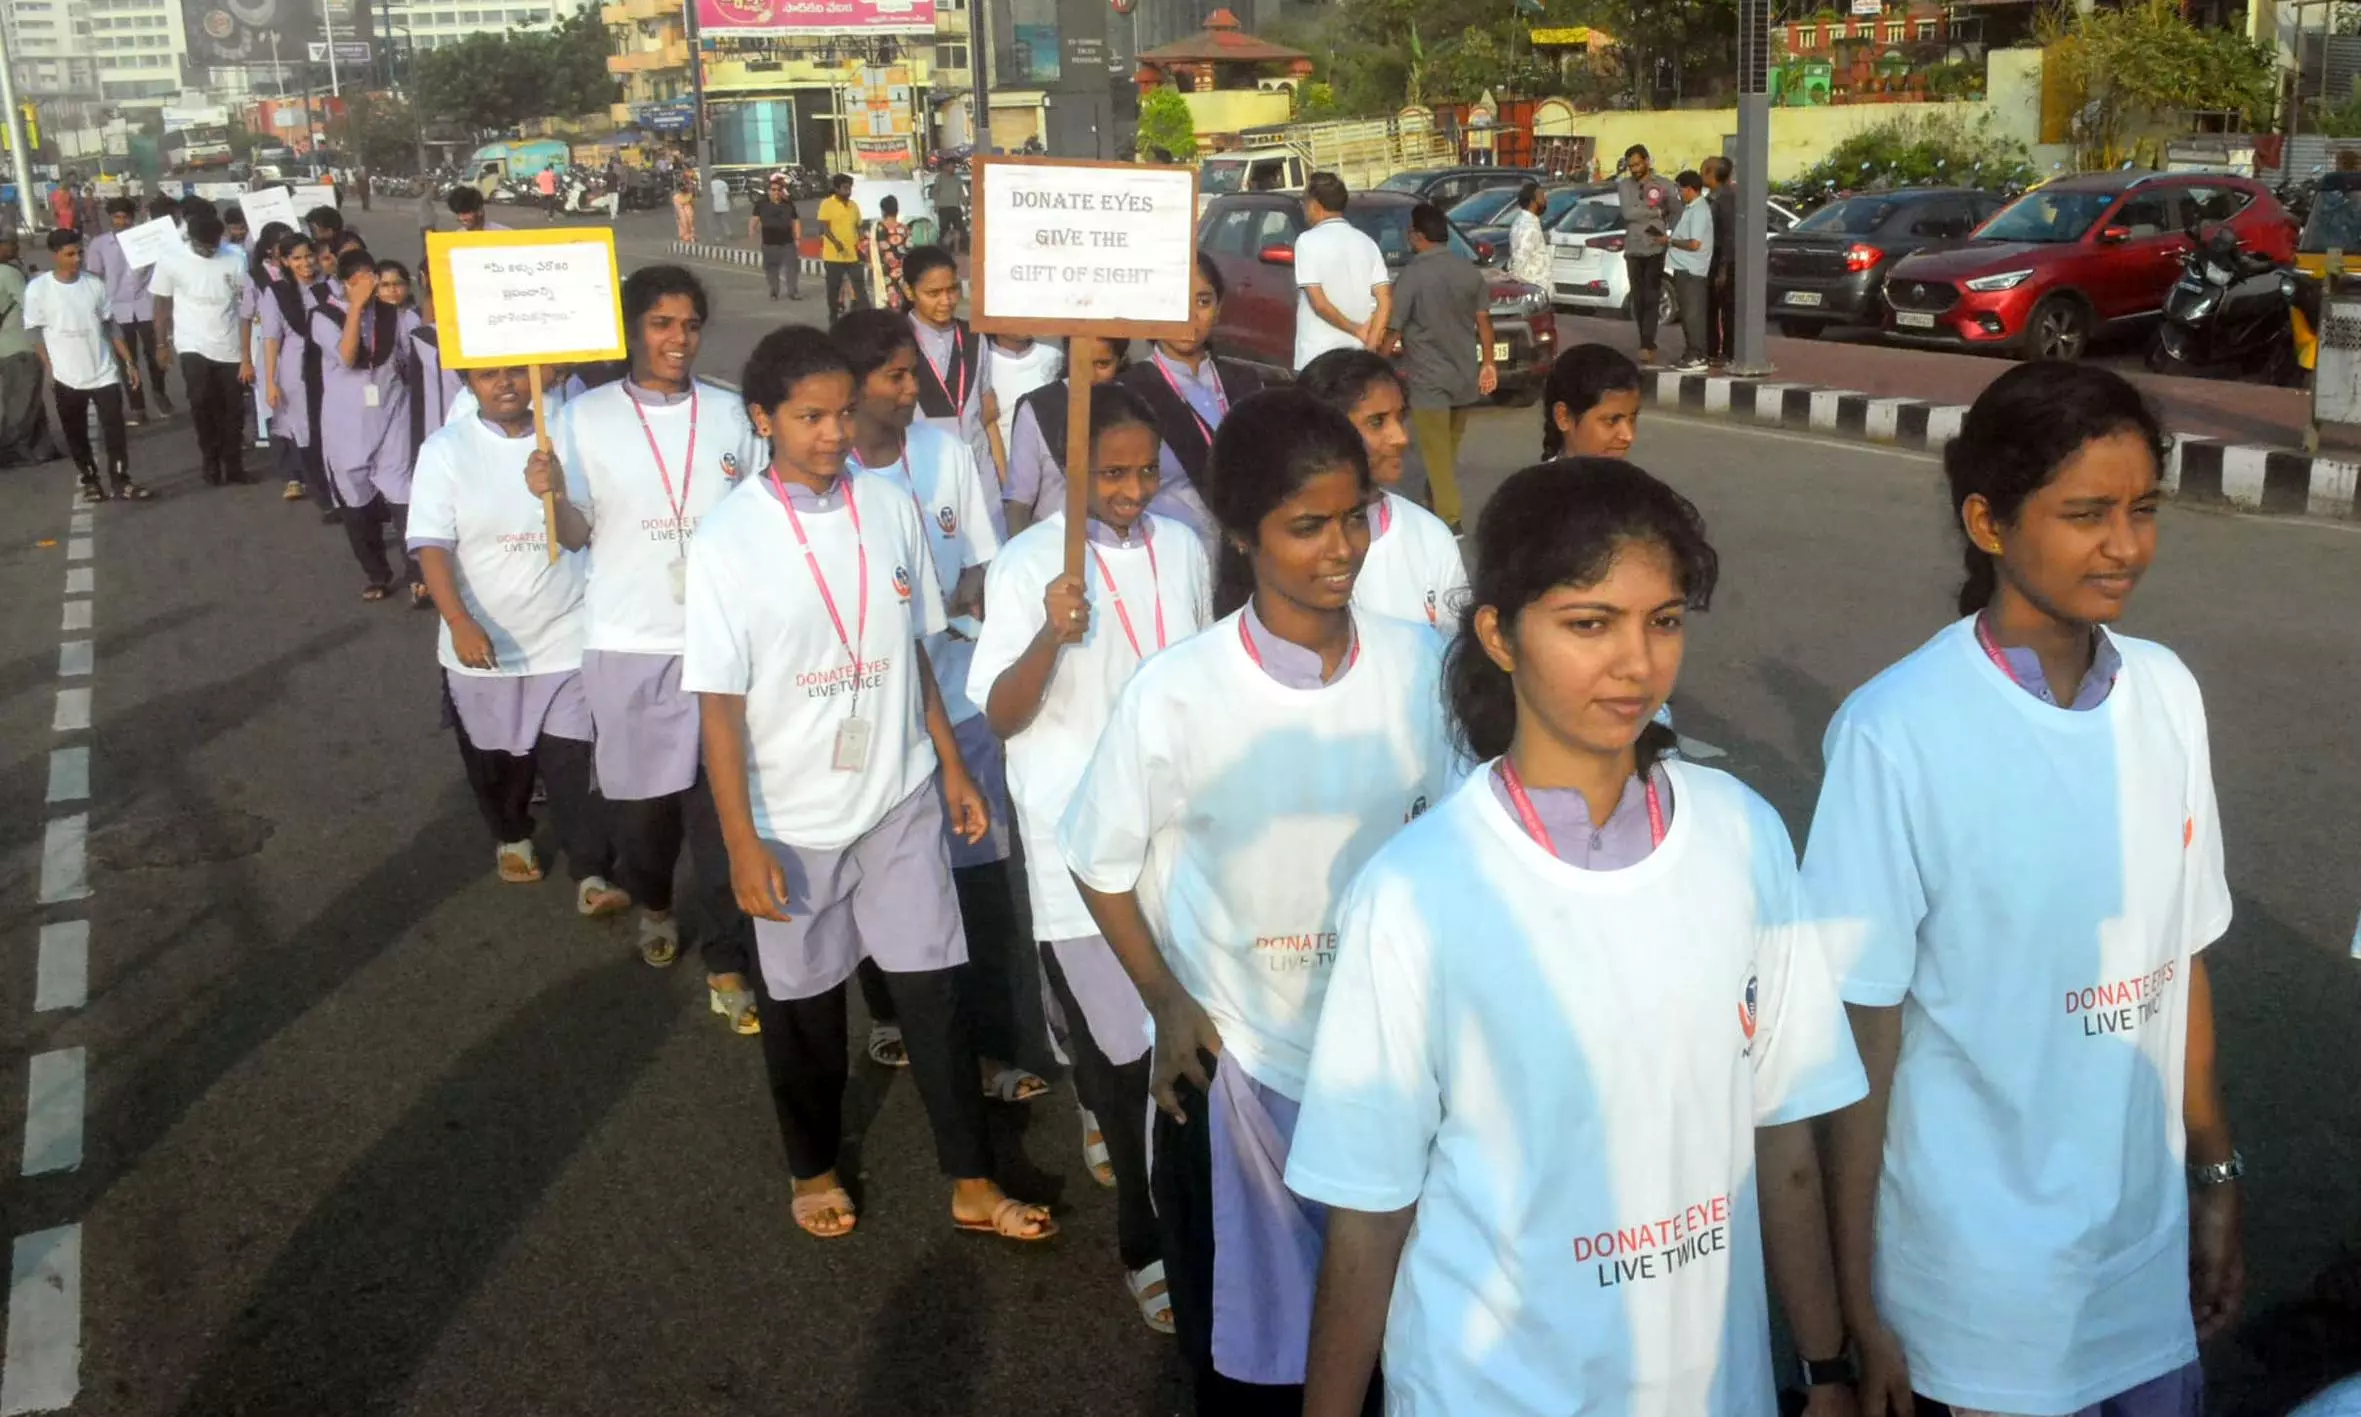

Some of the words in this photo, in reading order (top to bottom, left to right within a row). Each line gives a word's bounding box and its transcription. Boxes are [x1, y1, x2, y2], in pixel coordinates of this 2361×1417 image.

[1011, 190, 1094, 211] DONATE
[1101, 192, 1153, 213] EYES
[1035, 227, 1084, 246] GIVE
[1090, 230, 1129, 248] THE
[1010, 264, 1056, 282] GIFT
[1062, 266, 1088, 283] OF
[1092, 267, 1154, 284] SIGHT
[641, 516, 690, 530] DONATE
[496, 531, 537, 543] DONATE
[651, 529, 676, 541] LIVE
[504, 543, 525, 552] LIVE
[796, 667, 853, 688] DONATE
[858, 658, 890, 677] EYES
[808, 684, 837, 698] LIVE
[1256, 932, 1338, 953] DONATE
[1270, 956, 1313, 972] LIVE
[2066, 974, 2149, 1014] DONATE
[2084, 1008, 2134, 1037] LIVE
[1573, 1214, 1683, 1263] DONATE
[1598, 1255, 1656, 1288] LIVE
[1661, 1226, 1726, 1273] TWICE
